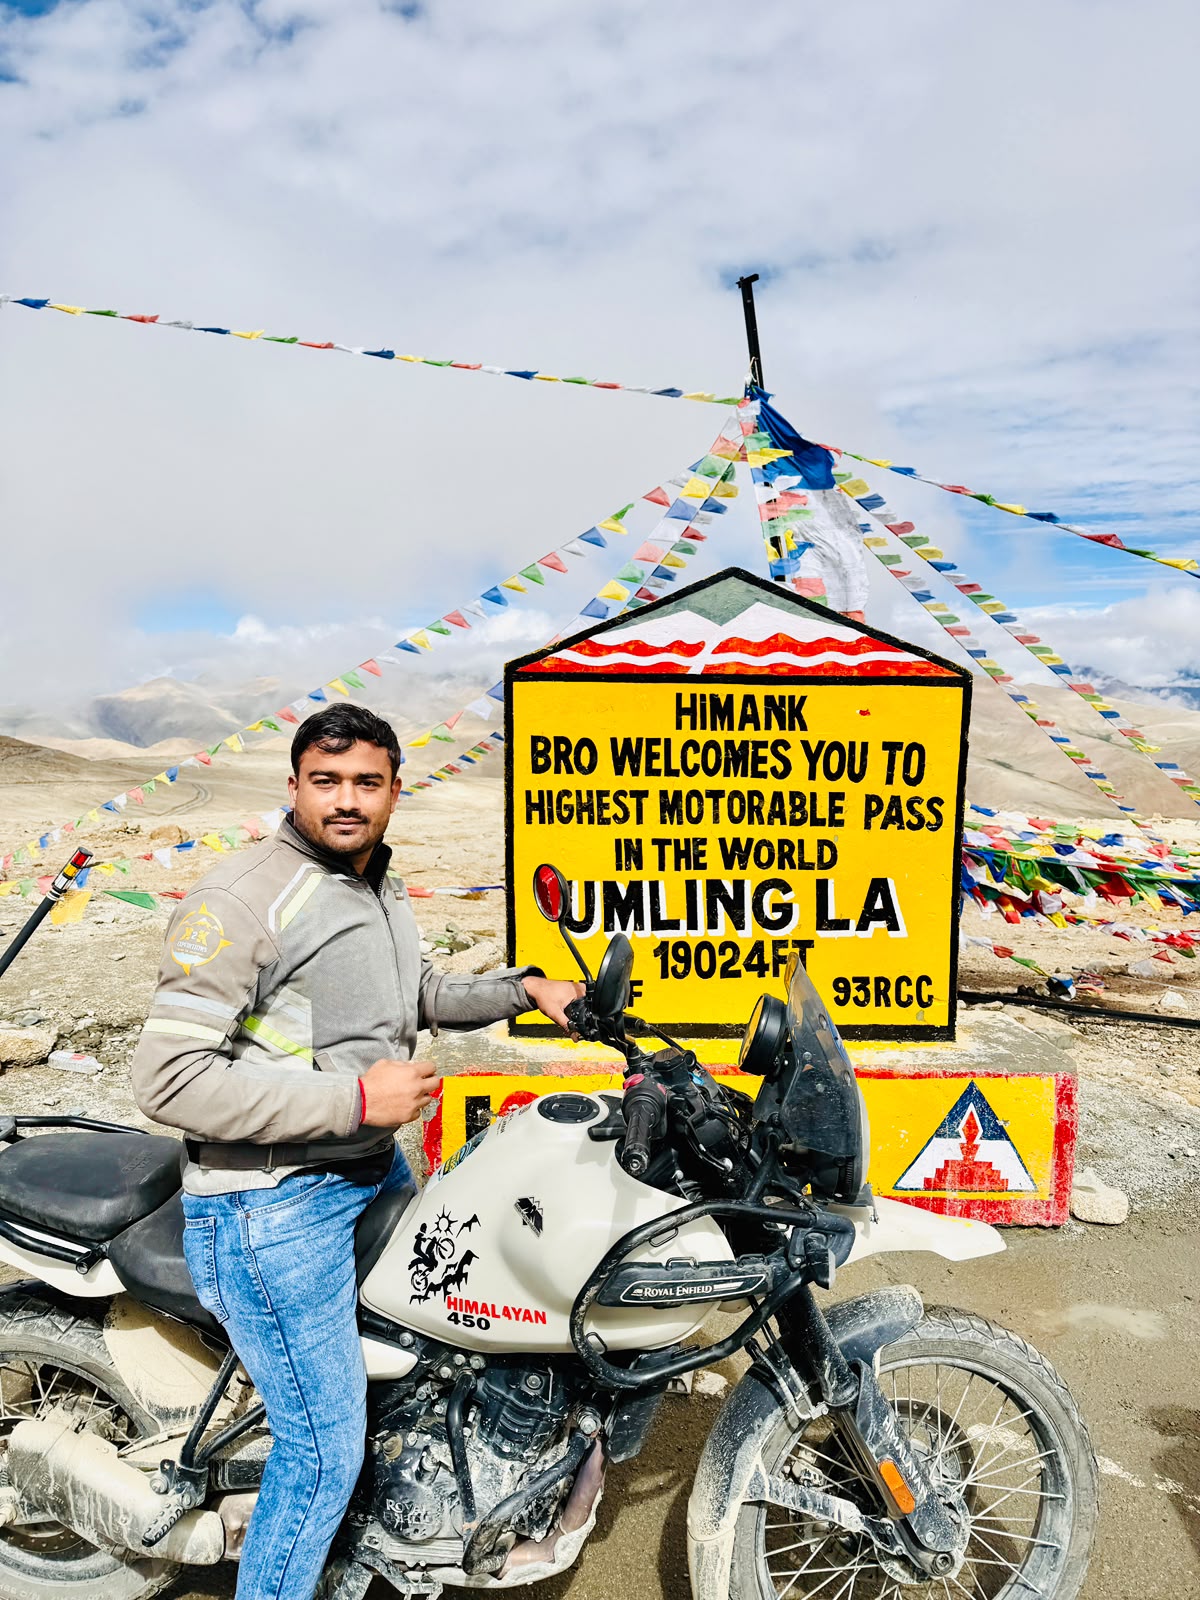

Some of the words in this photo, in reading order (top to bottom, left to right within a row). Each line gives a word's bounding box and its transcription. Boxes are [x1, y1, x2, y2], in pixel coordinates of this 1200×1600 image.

[530, 734, 598, 776] BRO
[609, 736, 792, 780] WELCOMES
[799, 739, 869, 784] YOU
[882, 741, 926, 787] TO
[525, 789, 649, 826] HIGHEST
[659, 789, 846, 828] MOTORABLE
[863, 793, 945, 832] PASS
[614, 838, 643, 872] IN
[651, 837, 708, 872] THE
[717, 837, 838, 872] WORLD
[565, 878, 797, 937] UMLING
[815, 877, 907, 937] LA
[653, 939, 815, 980] 19024FT
[832, 975, 934, 1009] 93RCC
[644, 1287, 675, 1298] ROYAL
[676, 1285, 713, 1296] ENFIELD
[446, 1295, 547, 1325] HIMALAYAN
[446, 1311, 491, 1331] 450
